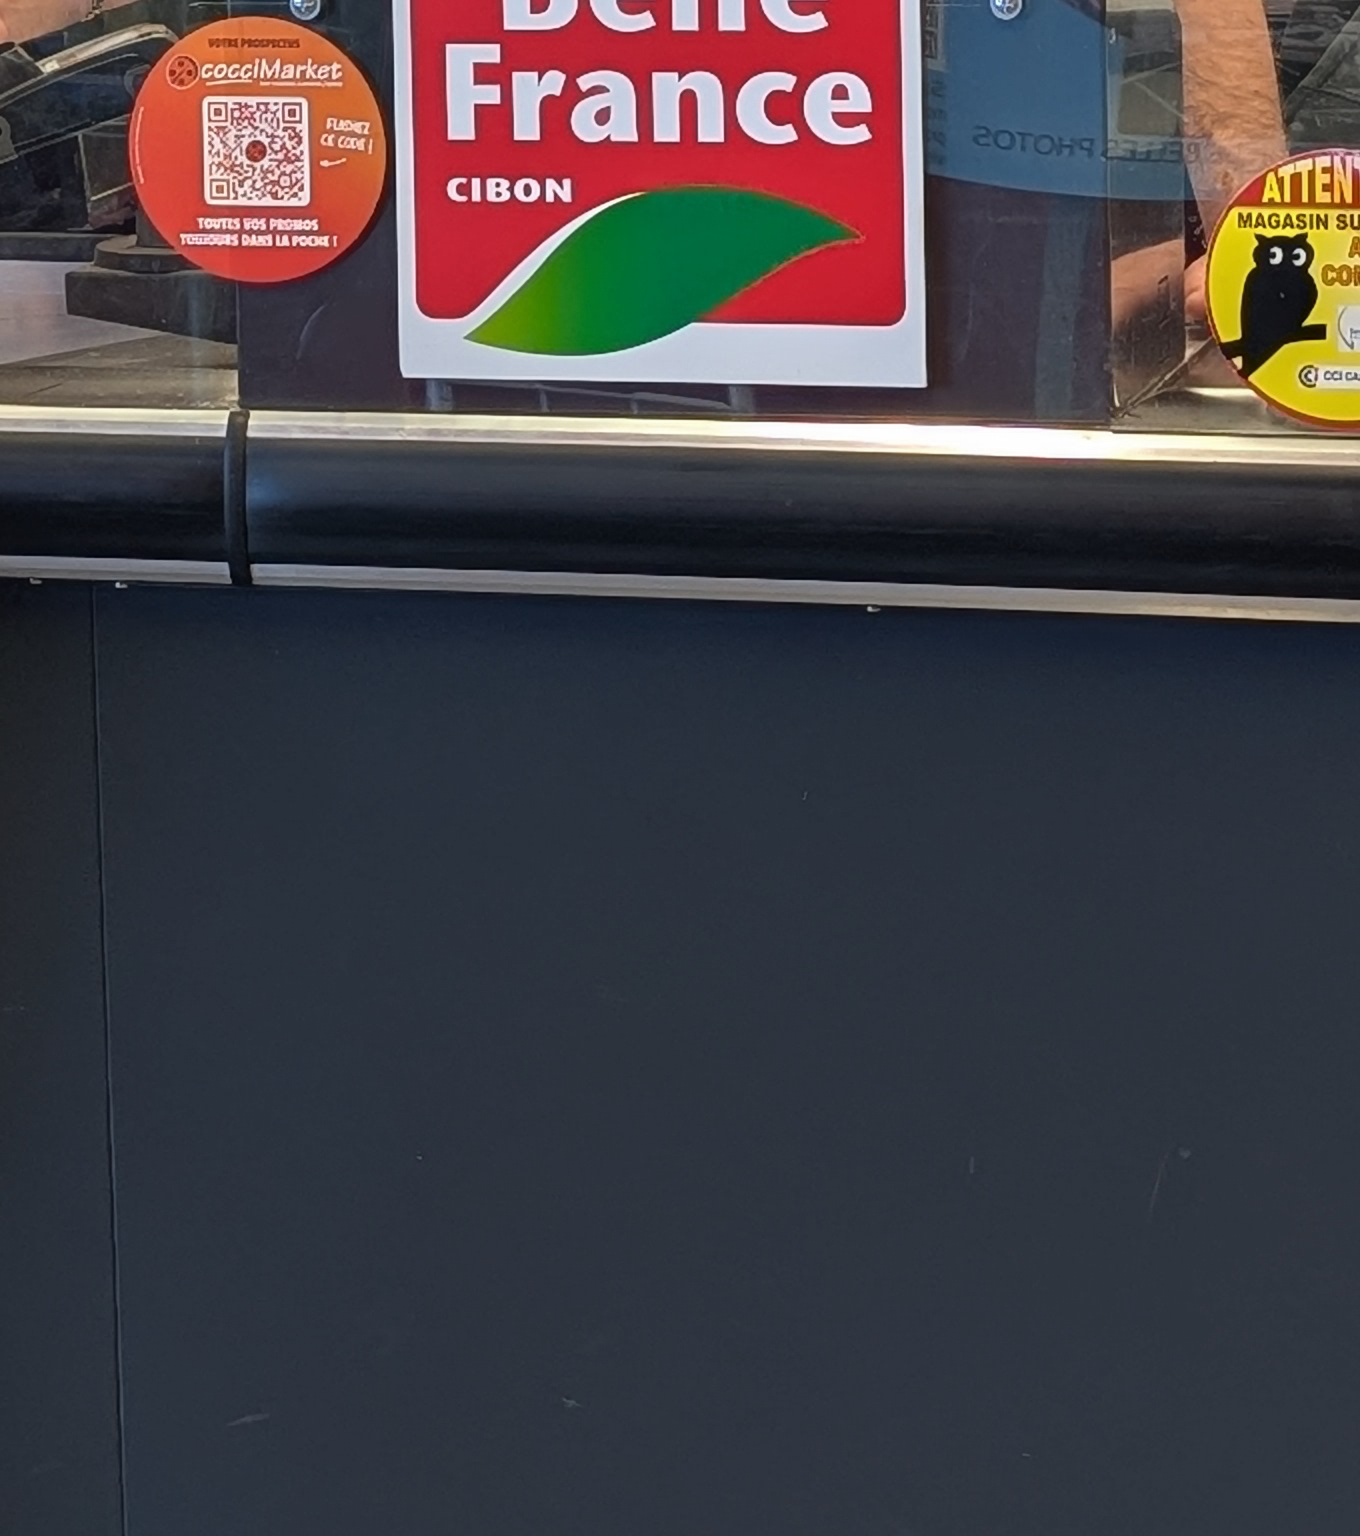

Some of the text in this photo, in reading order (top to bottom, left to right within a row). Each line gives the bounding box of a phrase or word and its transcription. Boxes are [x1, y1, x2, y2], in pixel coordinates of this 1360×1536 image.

[445, 43, 873, 146] France
[327, 118, 371, 135] FLASHEZ
[446, 176, 573, 203] CIBON
[197, 217, 319, 231] TOUTES VOS PROMOS
[1237, 212, 1329, 231] MAGASIN
[242, 233, 272, 247] DANS
[275, 234, 290, 247] LA
